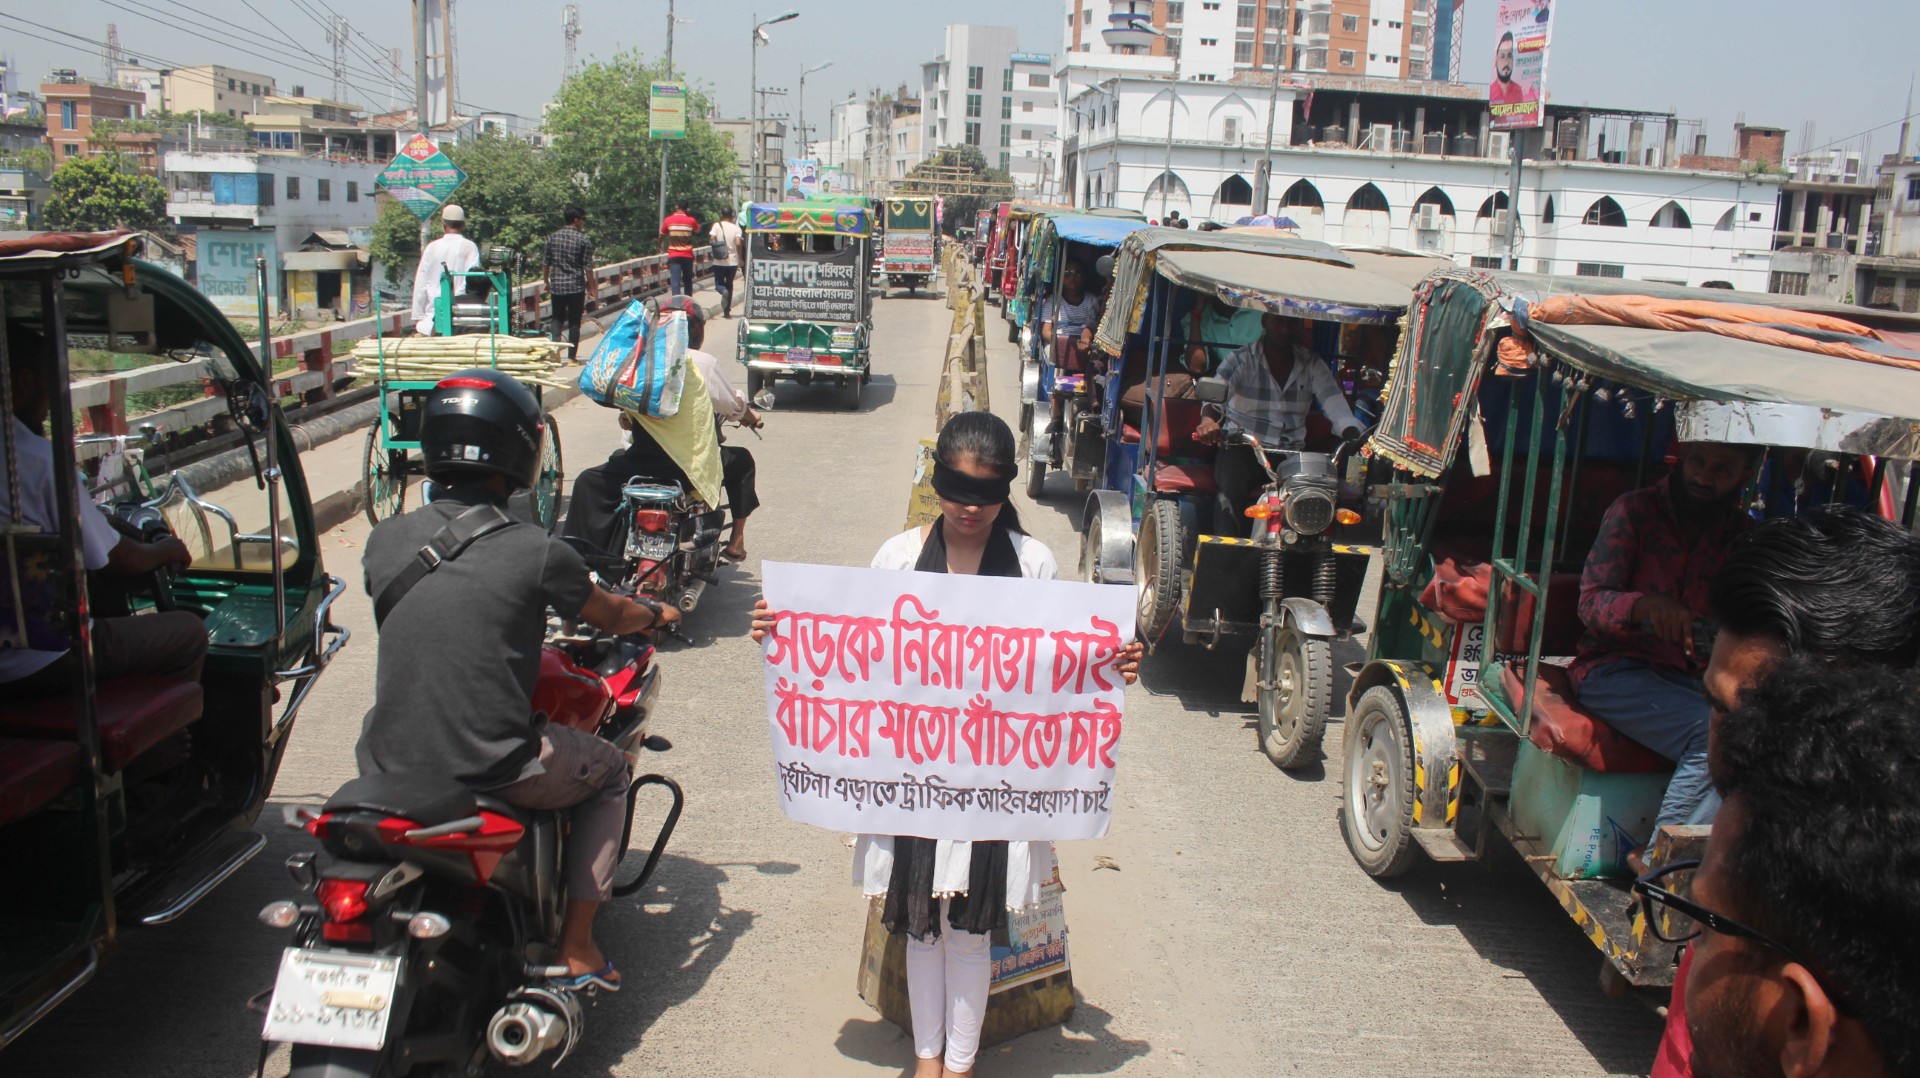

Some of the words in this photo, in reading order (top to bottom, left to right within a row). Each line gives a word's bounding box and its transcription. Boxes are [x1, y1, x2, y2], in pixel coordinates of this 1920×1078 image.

[200, 273, 248, 296] সিমেন্ট
[753, 259, 818, 287] সরদার
[818, 263, 854, 279] পরিবহন
[823, 289, 854, 300] সরদার
[765, 609, 886, 692] সড়কে
[891, 593, 1045, 694] নিরাপত্তা
[1050, 615, 1122, 694] চাই
[774, 676, 878, 759] বাঁচার
[878, 698, 960, 766] মতো
[960, 693, 1067, 770] বাঁচতে
[1067, 698, 1122, 769] চাই
[834, 777, 900, 812] এড়াতে
[899, 772, 976, 812] ট্রাফিক
[977, 780, 1028, 814] আইন
[1027, 787, 1079, 818] প্রয়োগ
[1080, 780, 1110, 814] চাই
[1590, 828, 1600, 840] PE
